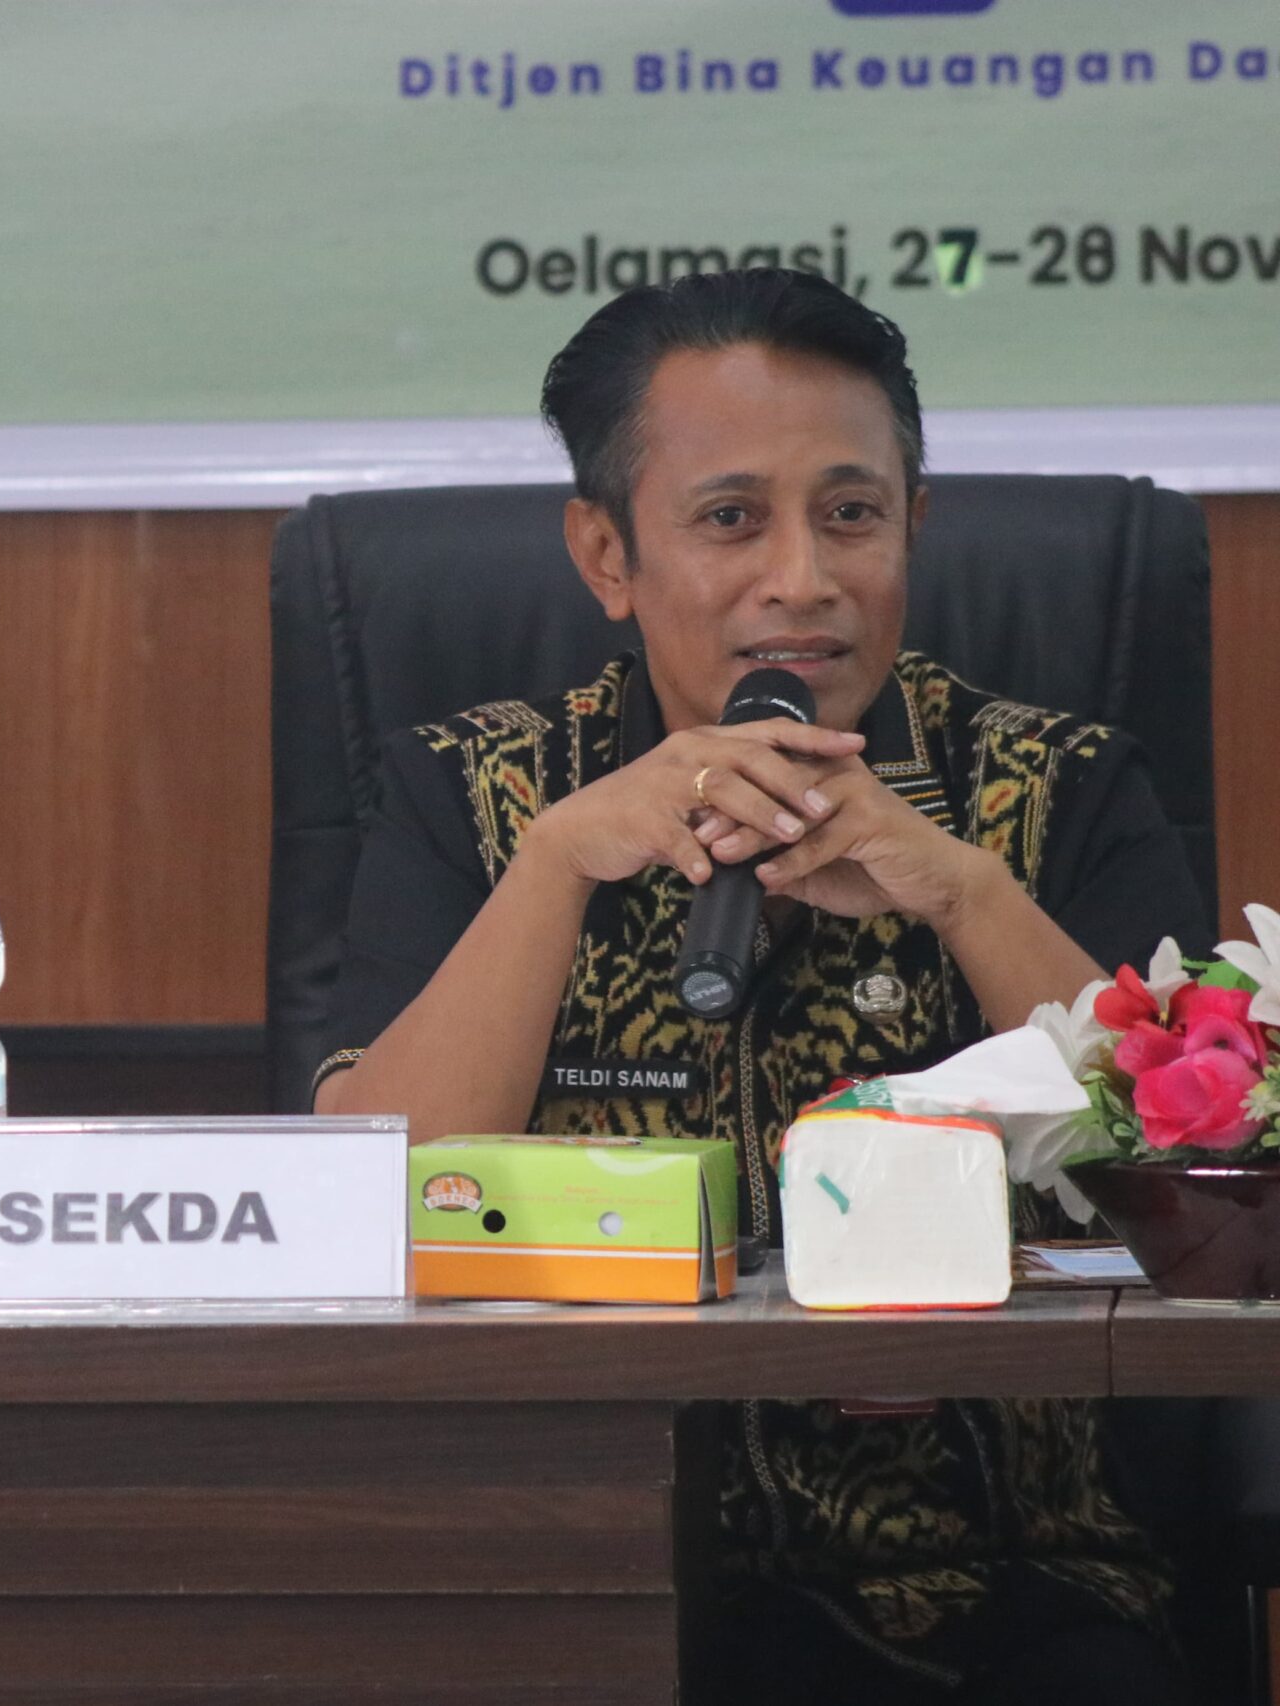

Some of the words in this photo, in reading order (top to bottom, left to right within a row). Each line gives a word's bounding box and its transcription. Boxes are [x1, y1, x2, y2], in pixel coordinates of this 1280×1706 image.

[400, 52, 602, 109] Ditjen
[634, 49, 779, 94] Bina
[812, 48, 1155, 99] Keuangan
[1188, 41, 1280, 82] Da
[554, 1068, 610, 1086] TELDI
[617, 1070, 687, 1088] SANAM
